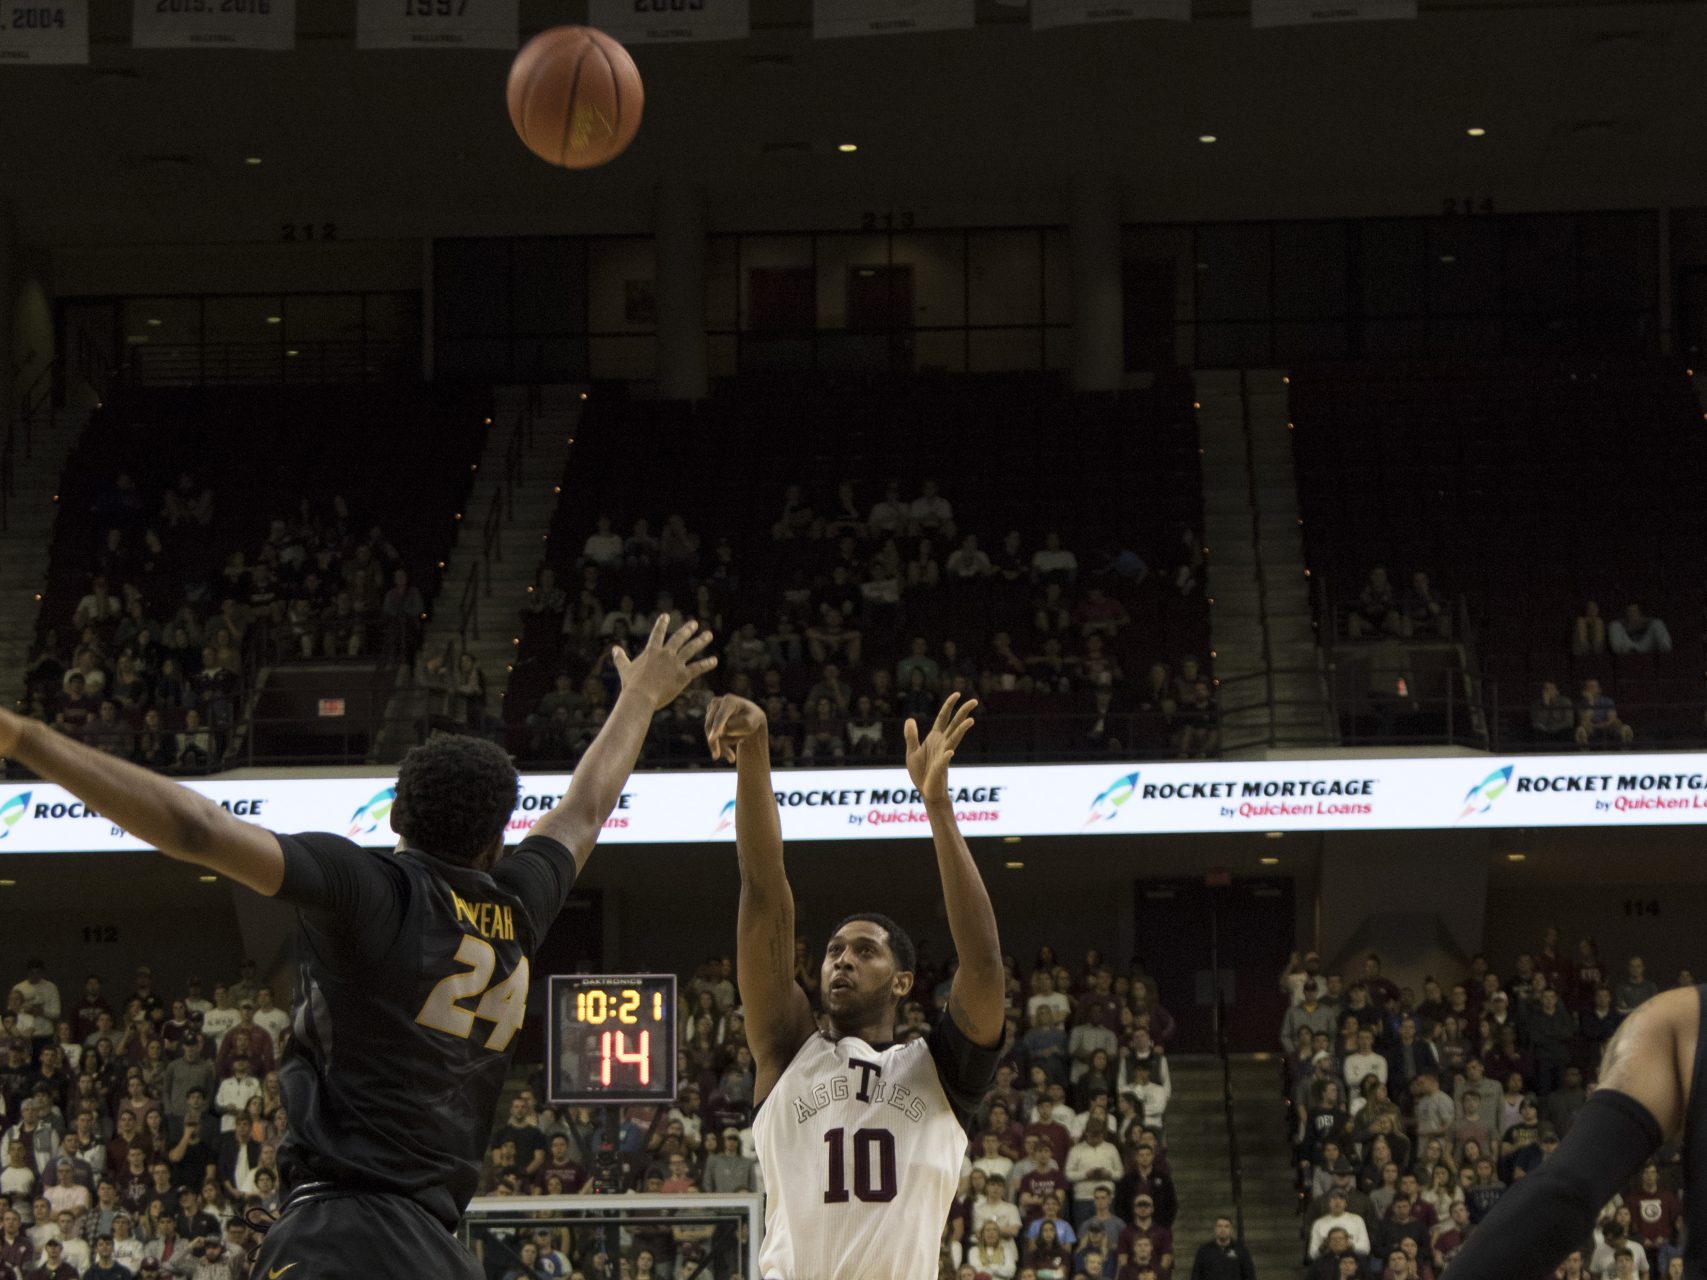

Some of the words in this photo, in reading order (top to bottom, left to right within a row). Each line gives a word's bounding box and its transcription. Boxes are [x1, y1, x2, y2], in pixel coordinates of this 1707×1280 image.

[13, 8, 65, 29] 2004
[281, 222, 337, 241] 212
[1142, 783, 1237, 799] ROCKET
[1242, 780, 1374, 797] MORTGAGE
[1516, 776, 1613, 792] ROCKET
[773, 789, 866, 807] ROCKET
[1595, 800, 1611, 811] by
[1614, 795, 1690, 811] Quicken
[1220, 806, 1235, 817] by
[1239, 802, 1312, 818] Quicken
[1316, 799, 1372, 815] Loans
[849, 813, 864, 825] by
[867, 809, 930, 825] Quicke
[955, 810, 999, 822] oans
[1623, 900, 1661, 917] 114
[82, 926, 117, 942] 112
[414, 933, 530, 1052] 24
[577, 989, 662, 1025] 10:21
[601, 1029, 650, 1086] 14
[824, 1127, 898, 1204] 10
